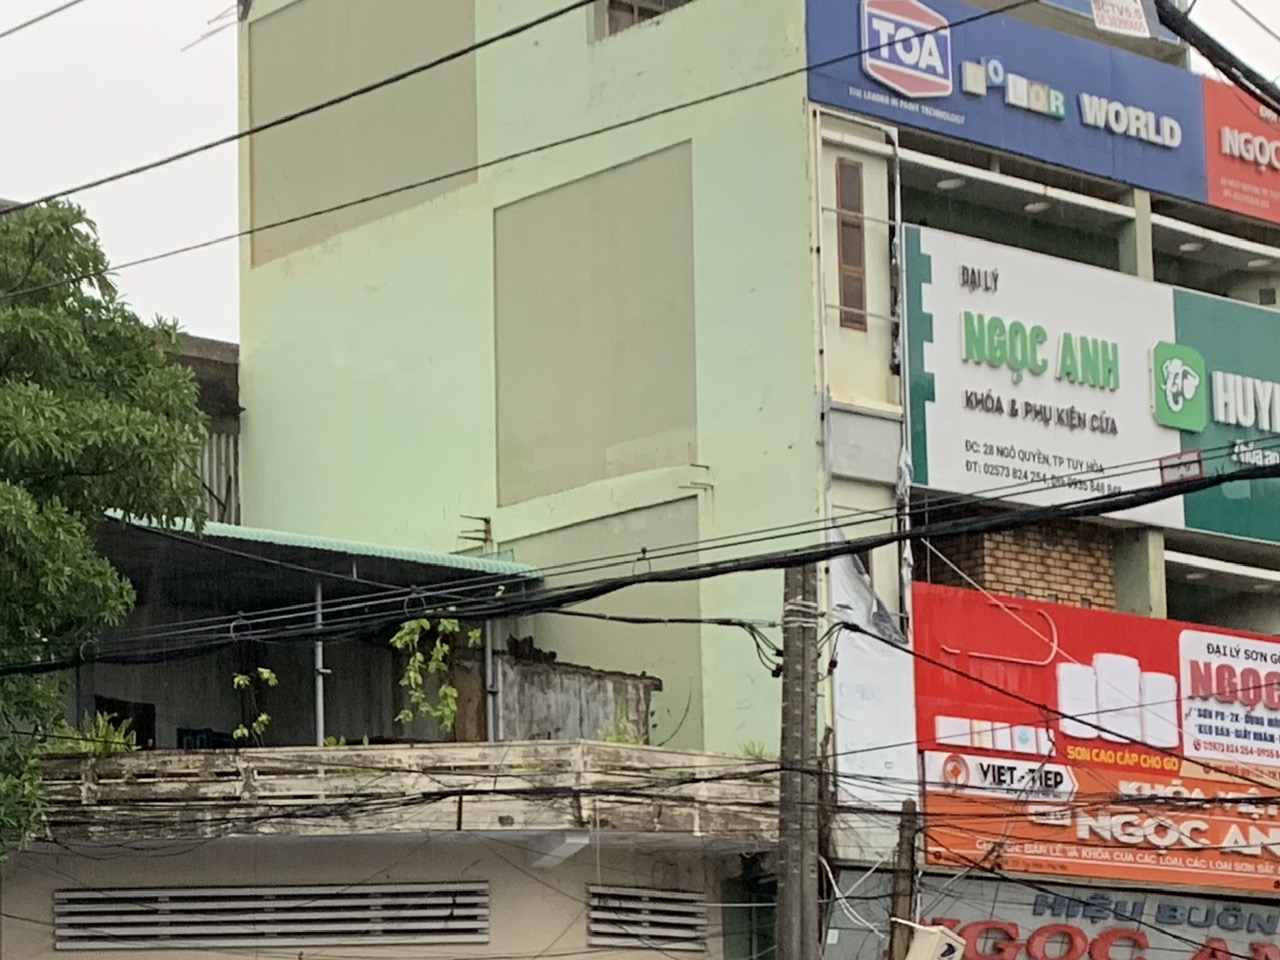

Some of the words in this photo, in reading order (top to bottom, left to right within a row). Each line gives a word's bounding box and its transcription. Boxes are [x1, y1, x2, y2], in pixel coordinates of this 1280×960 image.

[872, 18, 944, 74] TOA
[864, 90, 890, 104] LEADER
[900, 99, 920, 112] PAINT
[921, 105, 966, 125] TECHNOLOGY
[1079, 93, 1182, 148] WORLD
[984, 268, 999, 292] LÝ
[961, 311, 1049, 385] NGỌC
[1056, 332, 1119, 390] ANH
[964, 389, 1004, 415] KHÓA
[1008, 398, 1019, 417] &
[1022, 401, 1052, 427] PHỤ
[965, 439, 980, 453] ĐC:
[983, 443, 995, 456] 28
[996, 445, 1016, 459] NGÔ
[1018, 448, 1051, 468] QUYỀN,
[1053, 455, 1064, 468] TP
[1066, 457, 1084, 472] TUY
[966, 460, 982, 473] ĐT:
[983, 463, 1010, 478] 02573
[1012, 467, 1028, 480] 824
[1206, 643, 1227, 658] ĐẠI
[1230, 644, 1241, 658] LÝ
[1244, 648, 1267, 663] SƠN
[1091, 748, 1115, 764] CAO
[1140, 753, 1161, 769] CHO
[1076, 810, 1211, 855] NGỌC
[1081, 847, 1110, 860] KHÓA
[1136, 850, 1157, 864] CÁC
[1186, 854, 1207, 869] CÁC
[1032, 894, 1146, 925] HIỆU
